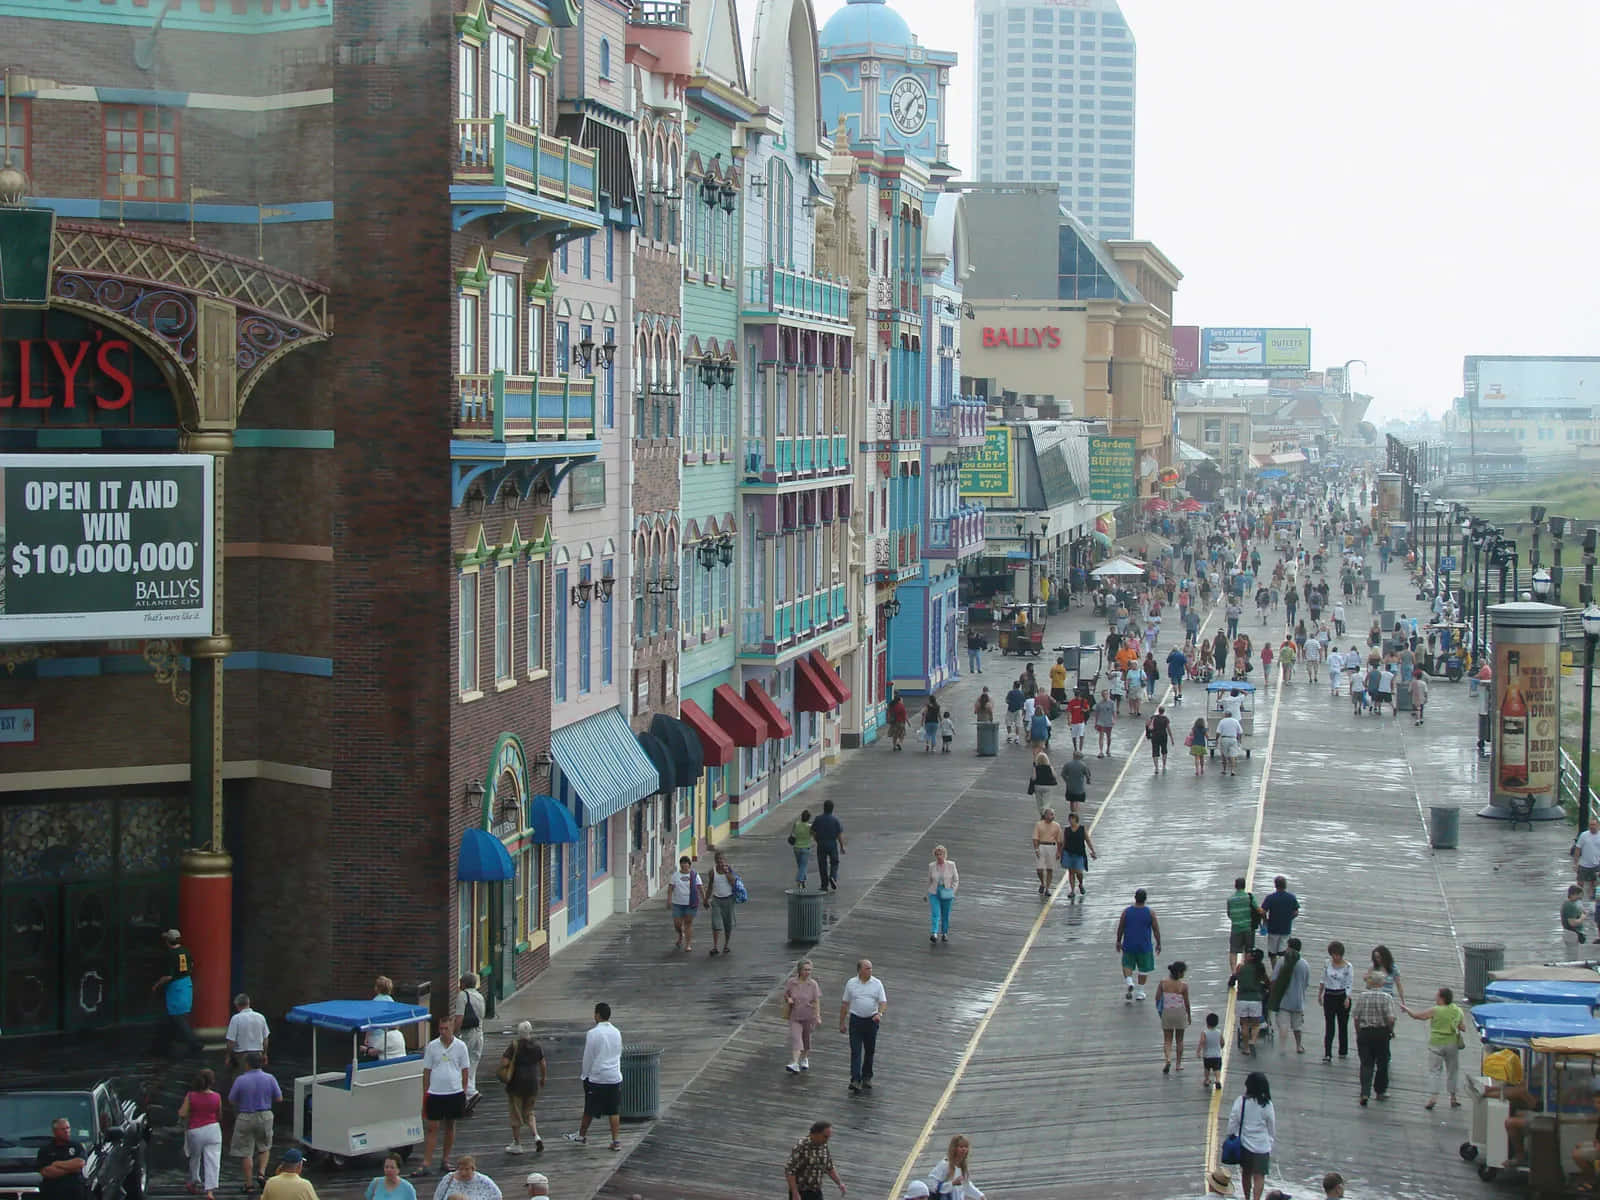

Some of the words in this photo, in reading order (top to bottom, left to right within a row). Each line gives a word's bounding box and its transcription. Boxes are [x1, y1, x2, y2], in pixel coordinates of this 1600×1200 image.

[982, 325, 1061, 348] BALLY'S
[1092, 439, 1131, 448] Garden
[1091, 456, 1133, 466] BUFFET
[25, 481, 91, 510] OPEN
[100, 481, 121, 509] IT
[128, 480, 178, 509] AND
[83, 512, 130, 541] WIN
[136, 578, 200, 599] BALLY'S
[136, 599, 177, 607] ATLANTIC
